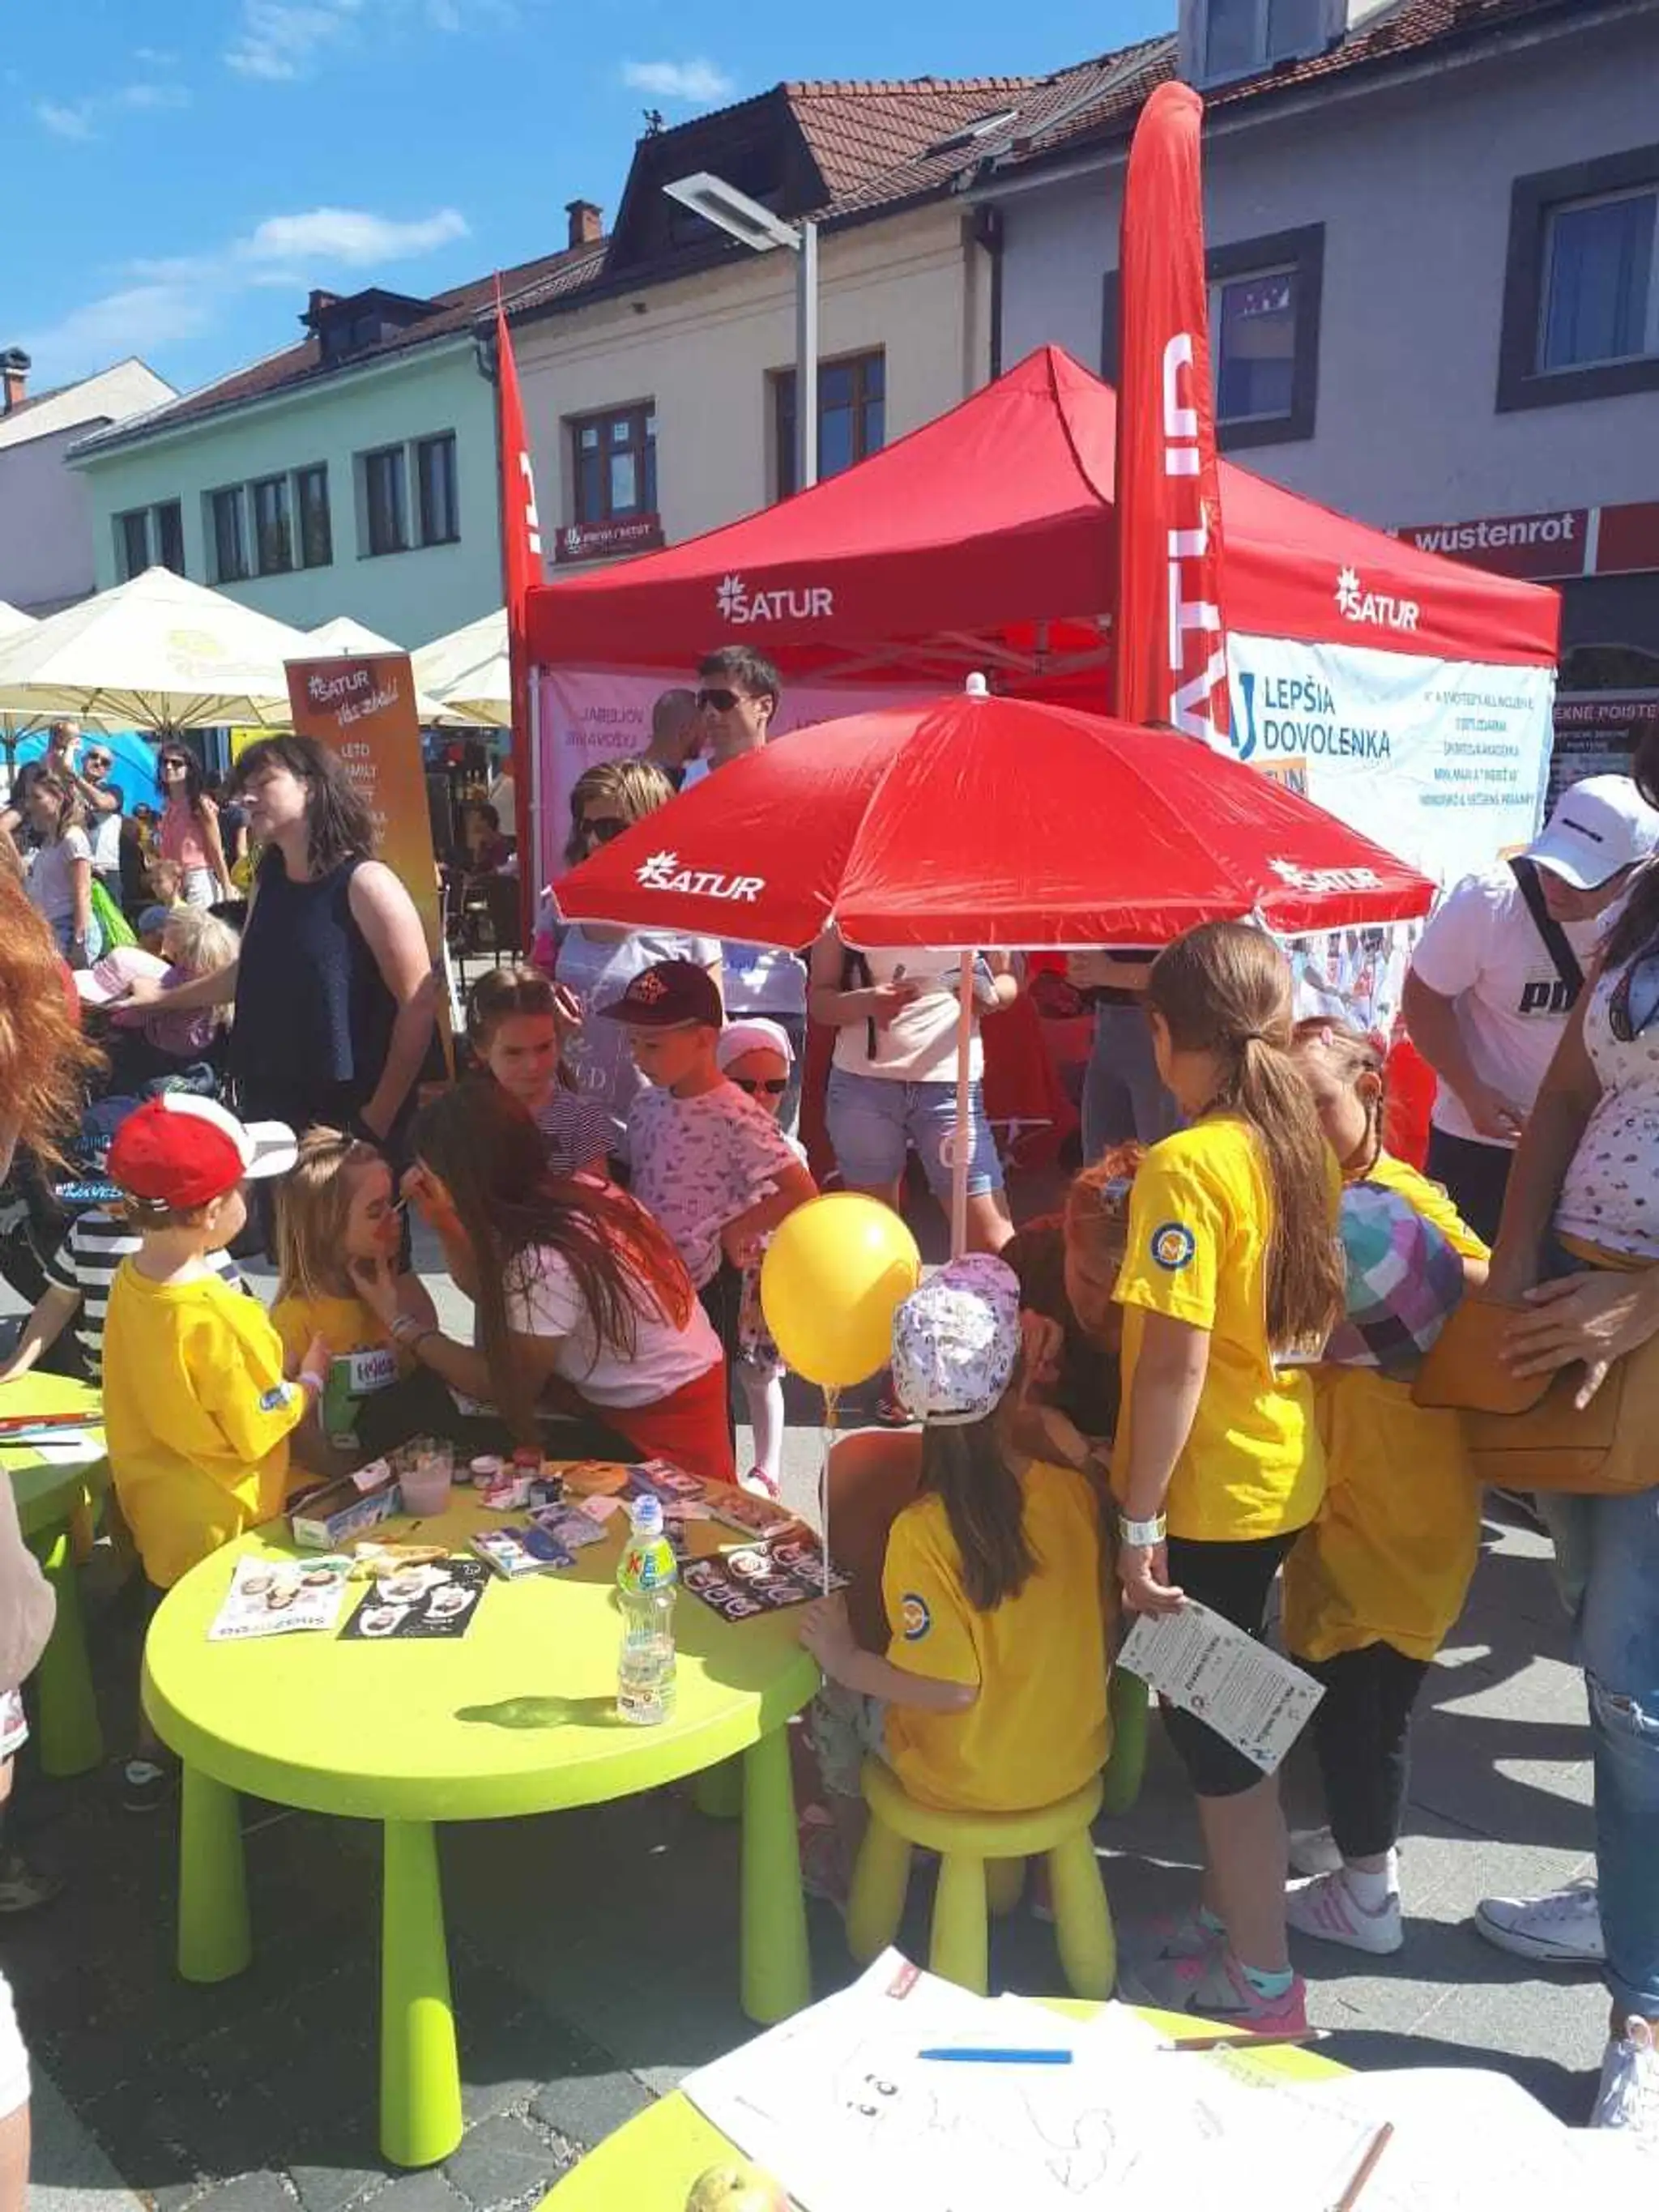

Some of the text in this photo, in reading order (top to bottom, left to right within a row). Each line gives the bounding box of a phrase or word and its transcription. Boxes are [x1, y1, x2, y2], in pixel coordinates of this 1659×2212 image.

[1415, 512, 1575, 552] wüstenrot
[731, 586, 833, 624] SATUR
[1344, 592, 1419, 631] SATUR
[319, 670, 370, 702] SATUR
[1265, 674, 1336, 714] LEPŠIA
[1264, 719, 1390, 758] DOVOLENKA
[642, 868, 766, 902] SATUR
[1298, 867, 1383, 892] SATUR
